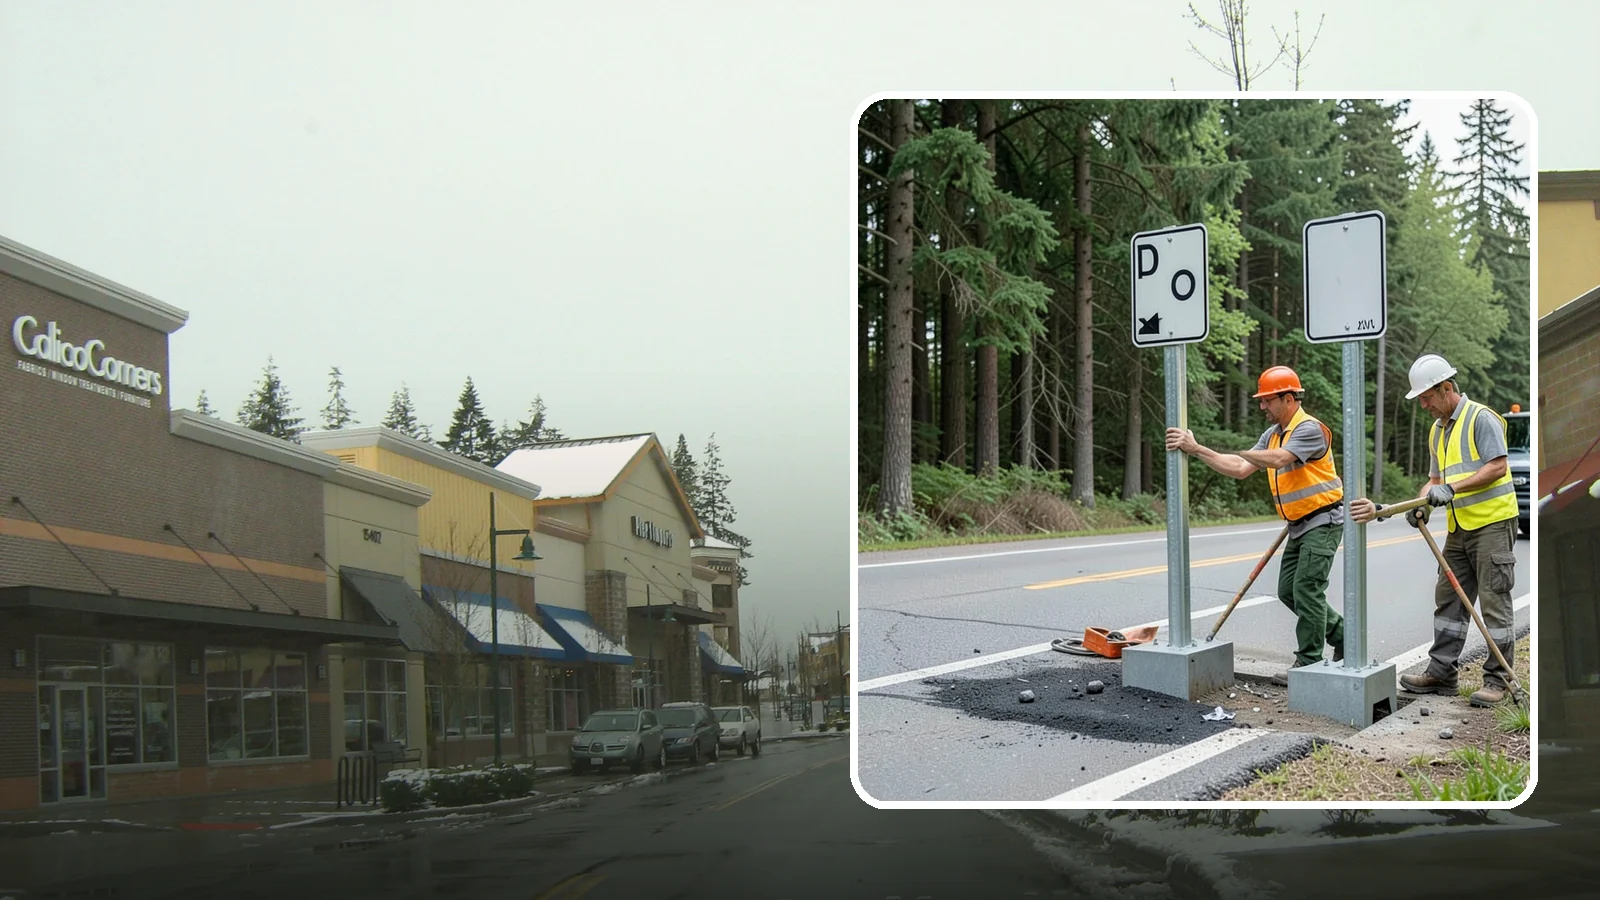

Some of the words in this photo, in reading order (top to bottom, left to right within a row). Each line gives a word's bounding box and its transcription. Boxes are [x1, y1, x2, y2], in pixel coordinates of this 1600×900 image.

[17, 360, 47, 377] FABRICS
[52, 371, 78, 386] WINDOW
[79, 379, 116, 399] TREATMENTS
